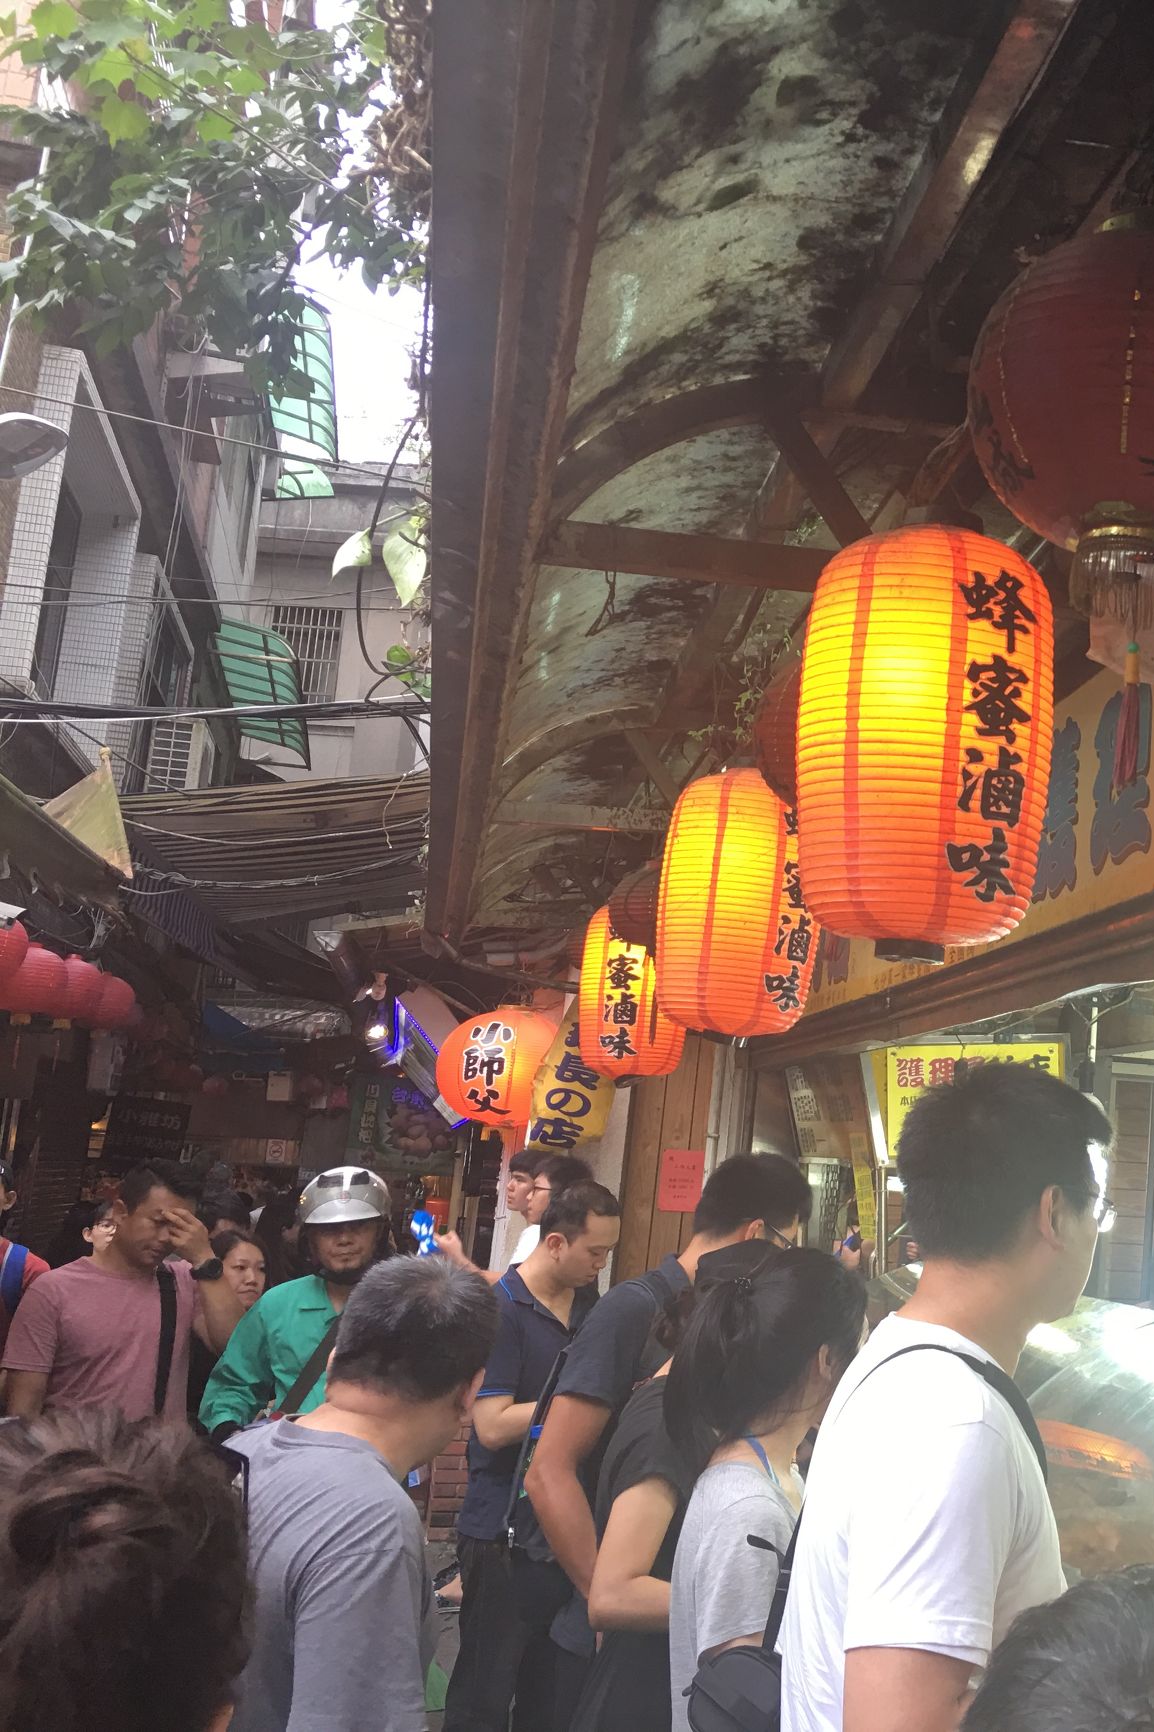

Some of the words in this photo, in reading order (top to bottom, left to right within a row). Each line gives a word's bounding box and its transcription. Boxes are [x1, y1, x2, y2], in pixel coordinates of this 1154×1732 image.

[944, 567, 1040, 904] 蜂蜜滷味
[463, 1022, 514, 1115] 小師父
